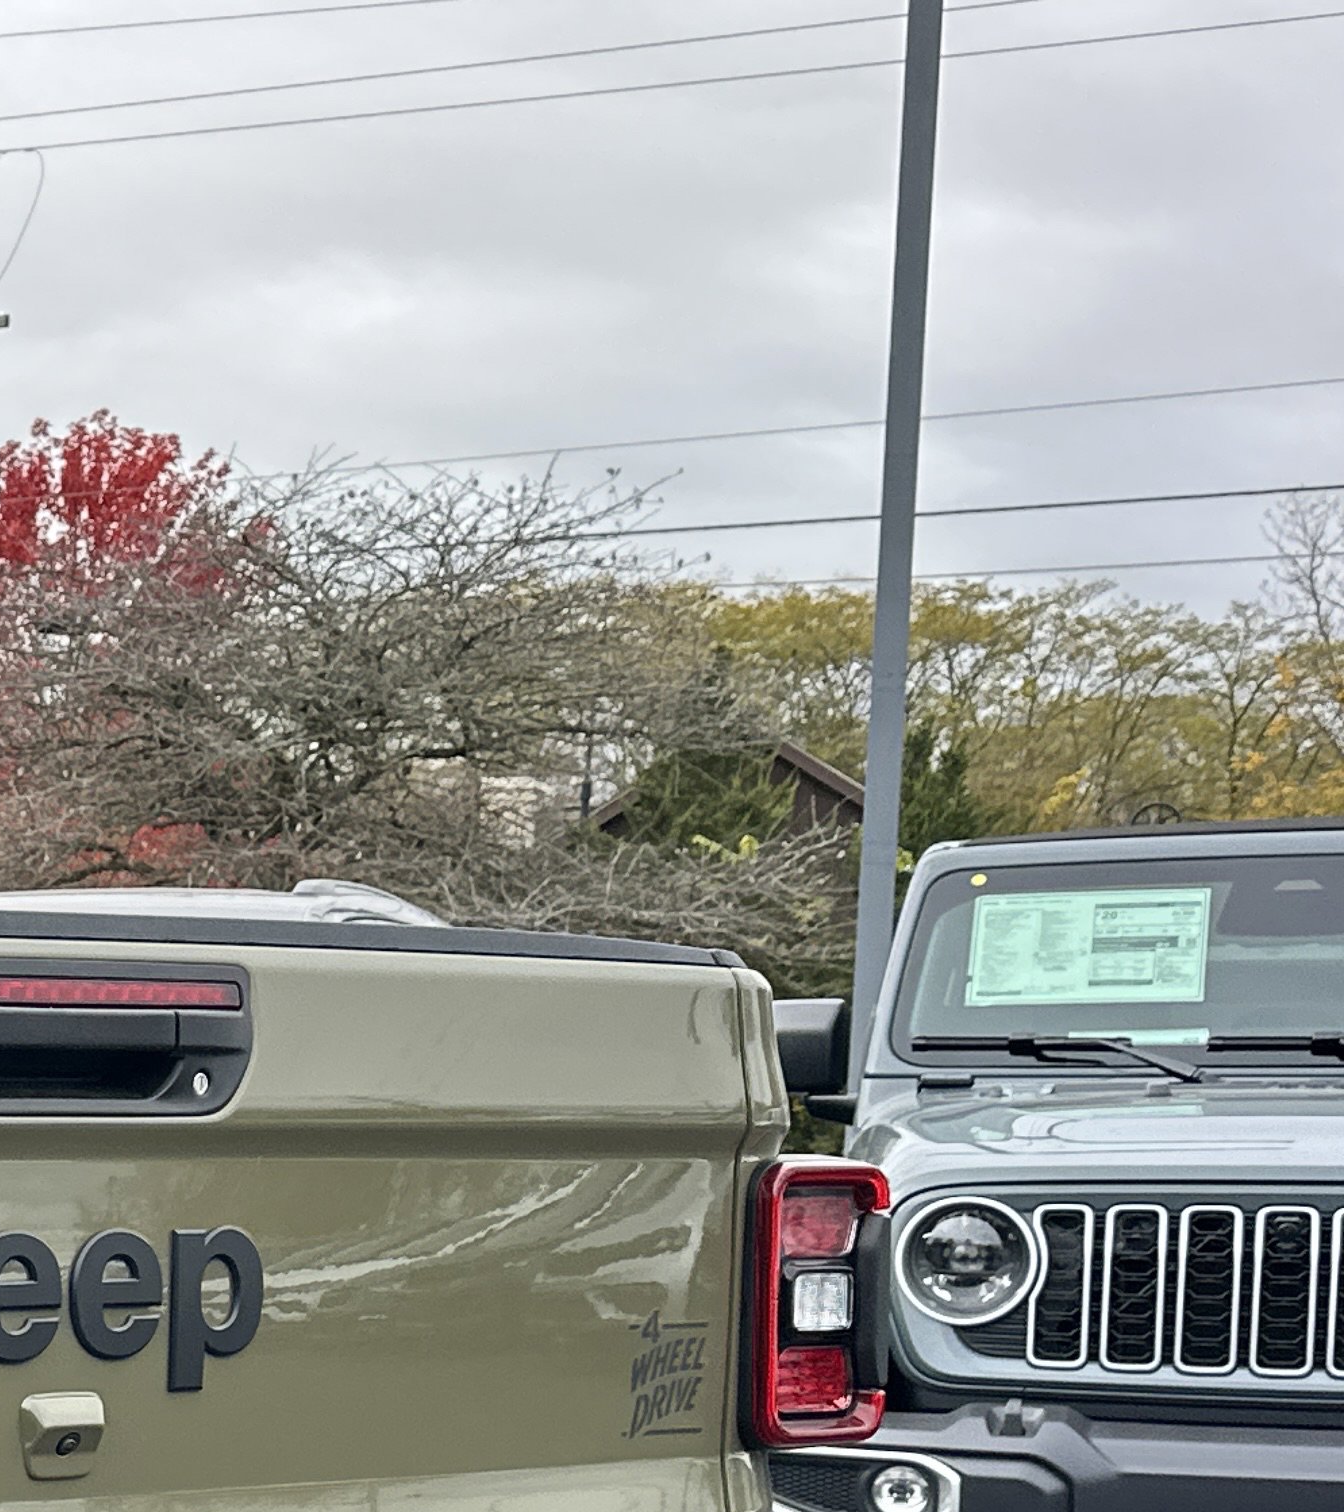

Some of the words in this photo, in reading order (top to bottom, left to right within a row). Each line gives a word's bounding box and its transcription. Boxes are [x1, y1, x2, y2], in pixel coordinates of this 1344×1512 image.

[641, 1309, 660, 1343] 4
[631, 1337, 706, 1392] WHEEL
[628, 1377, 702, 1439] DRIVE
